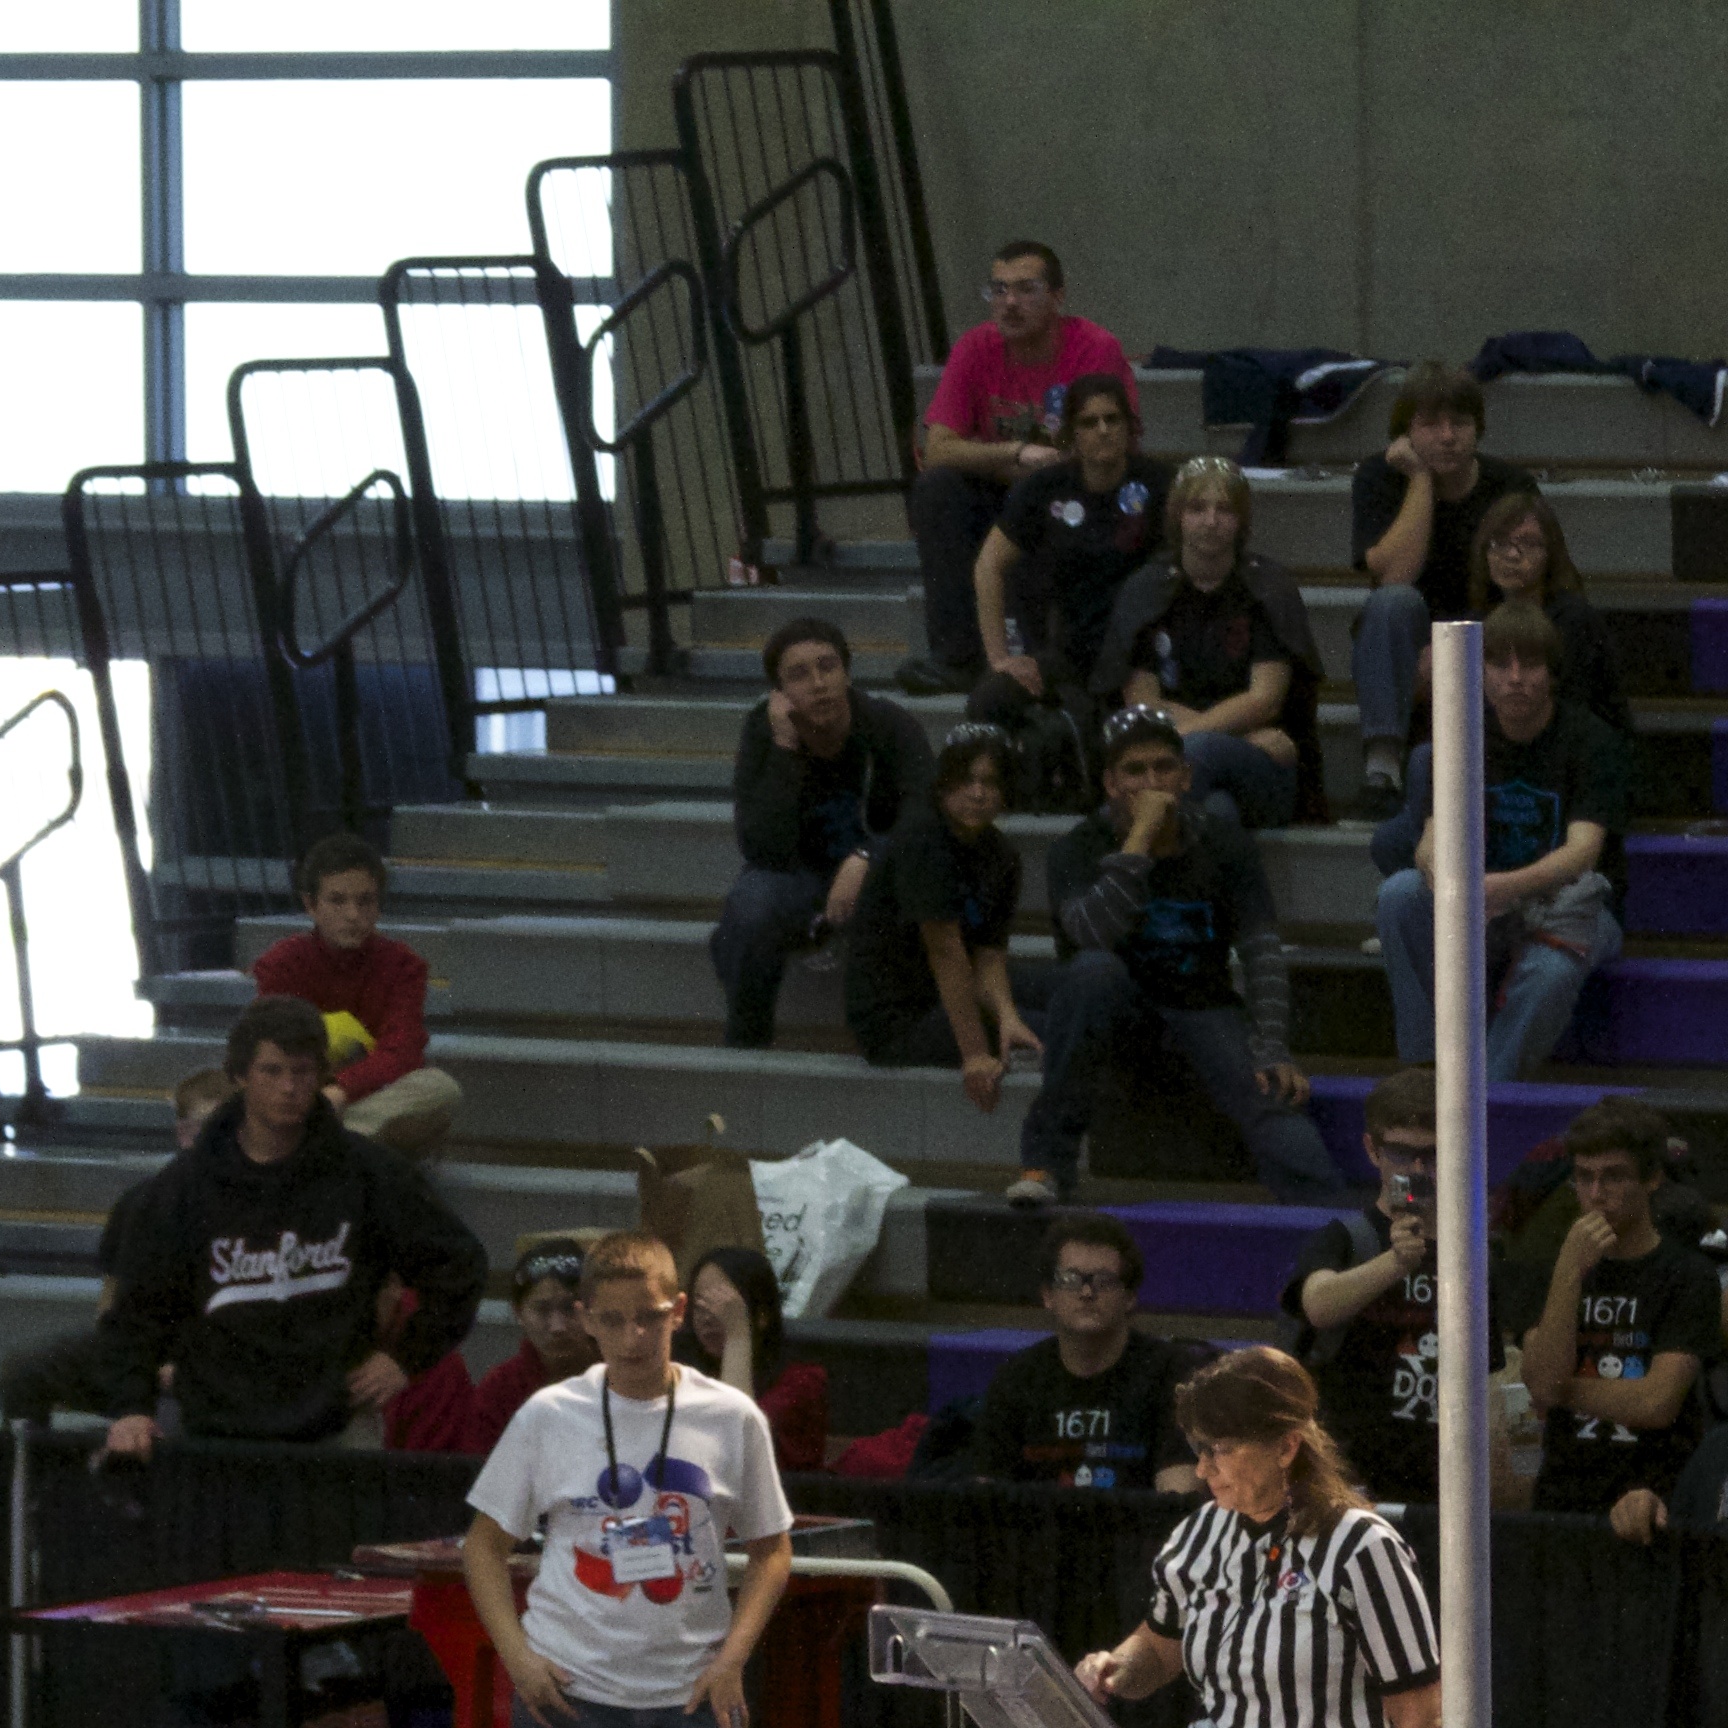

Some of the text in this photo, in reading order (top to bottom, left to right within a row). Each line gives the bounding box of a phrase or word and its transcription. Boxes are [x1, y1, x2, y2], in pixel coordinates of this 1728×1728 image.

[210, 1222, 352, 1292] Stanford
[1583, 1296, 1639, 1325] 1671
[1055, 1409, 1112, 1439] 1671
